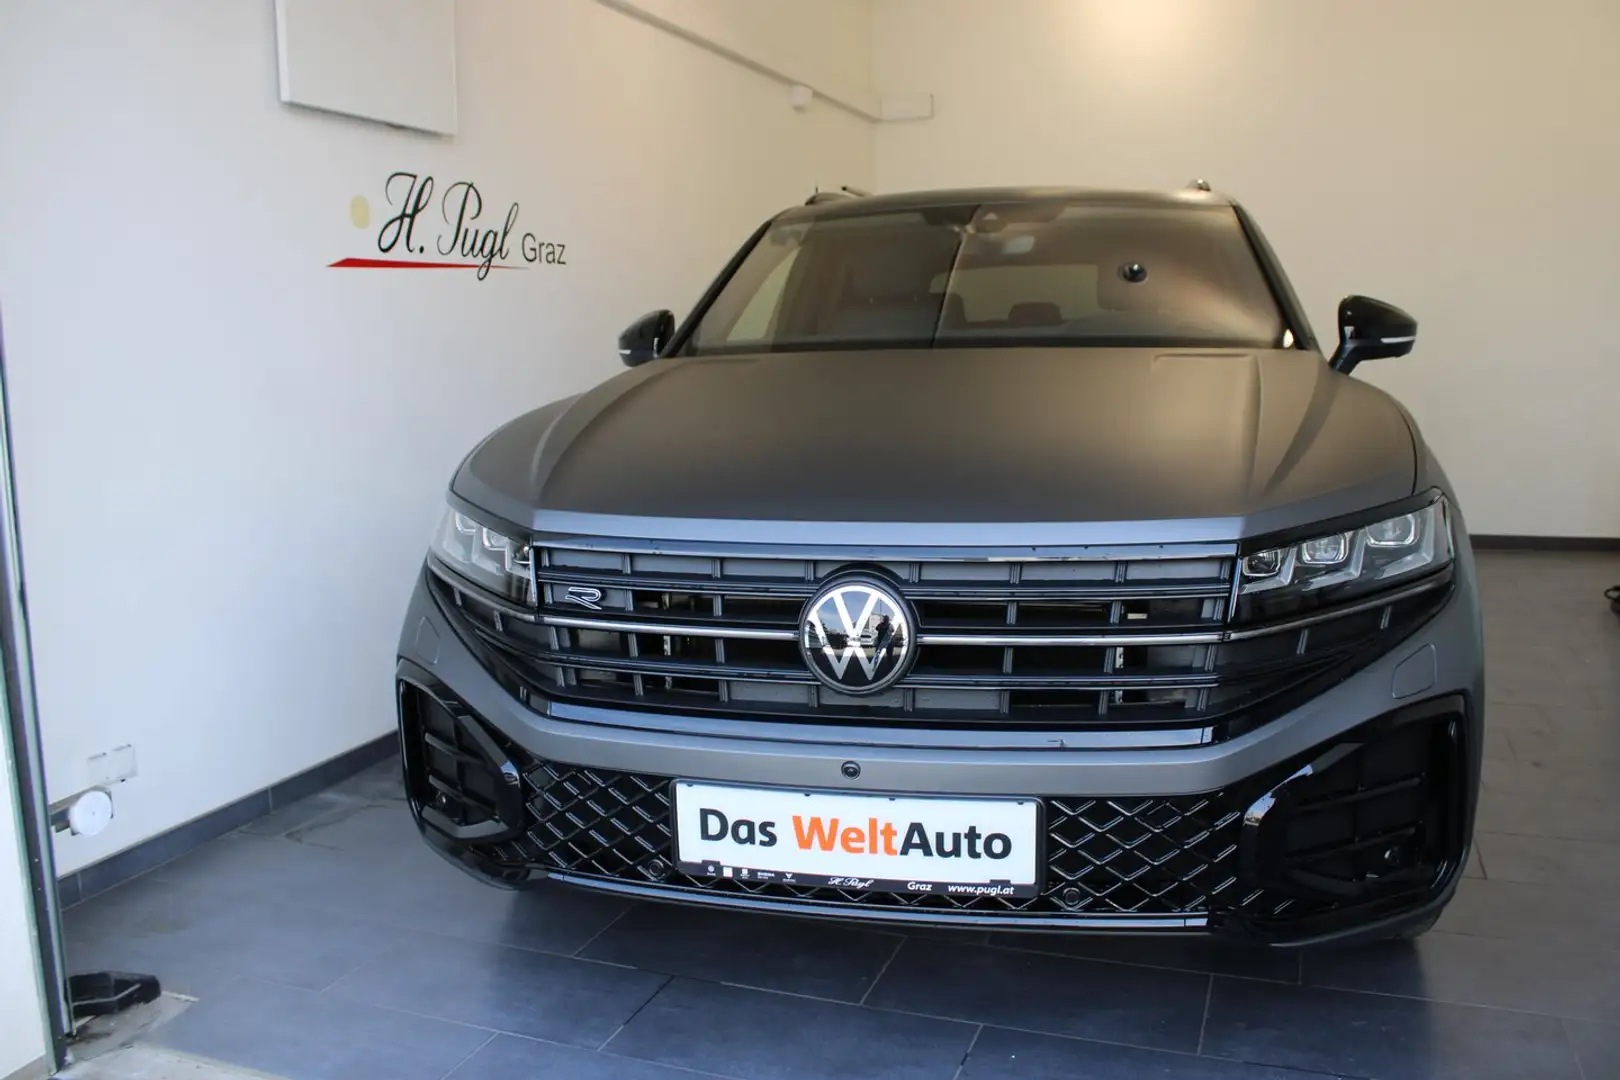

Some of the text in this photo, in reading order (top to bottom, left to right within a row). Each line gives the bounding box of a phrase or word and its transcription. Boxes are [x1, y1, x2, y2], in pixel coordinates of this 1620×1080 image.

[436, 181, 519, 281] Pugl
[521, 232, 567, 265] Graz
[699, 807, 1013, 861] Das WeltAuto
[907, 881, 932, 892] Graz
[947, 884, 1014, 896] www.pugl.at
